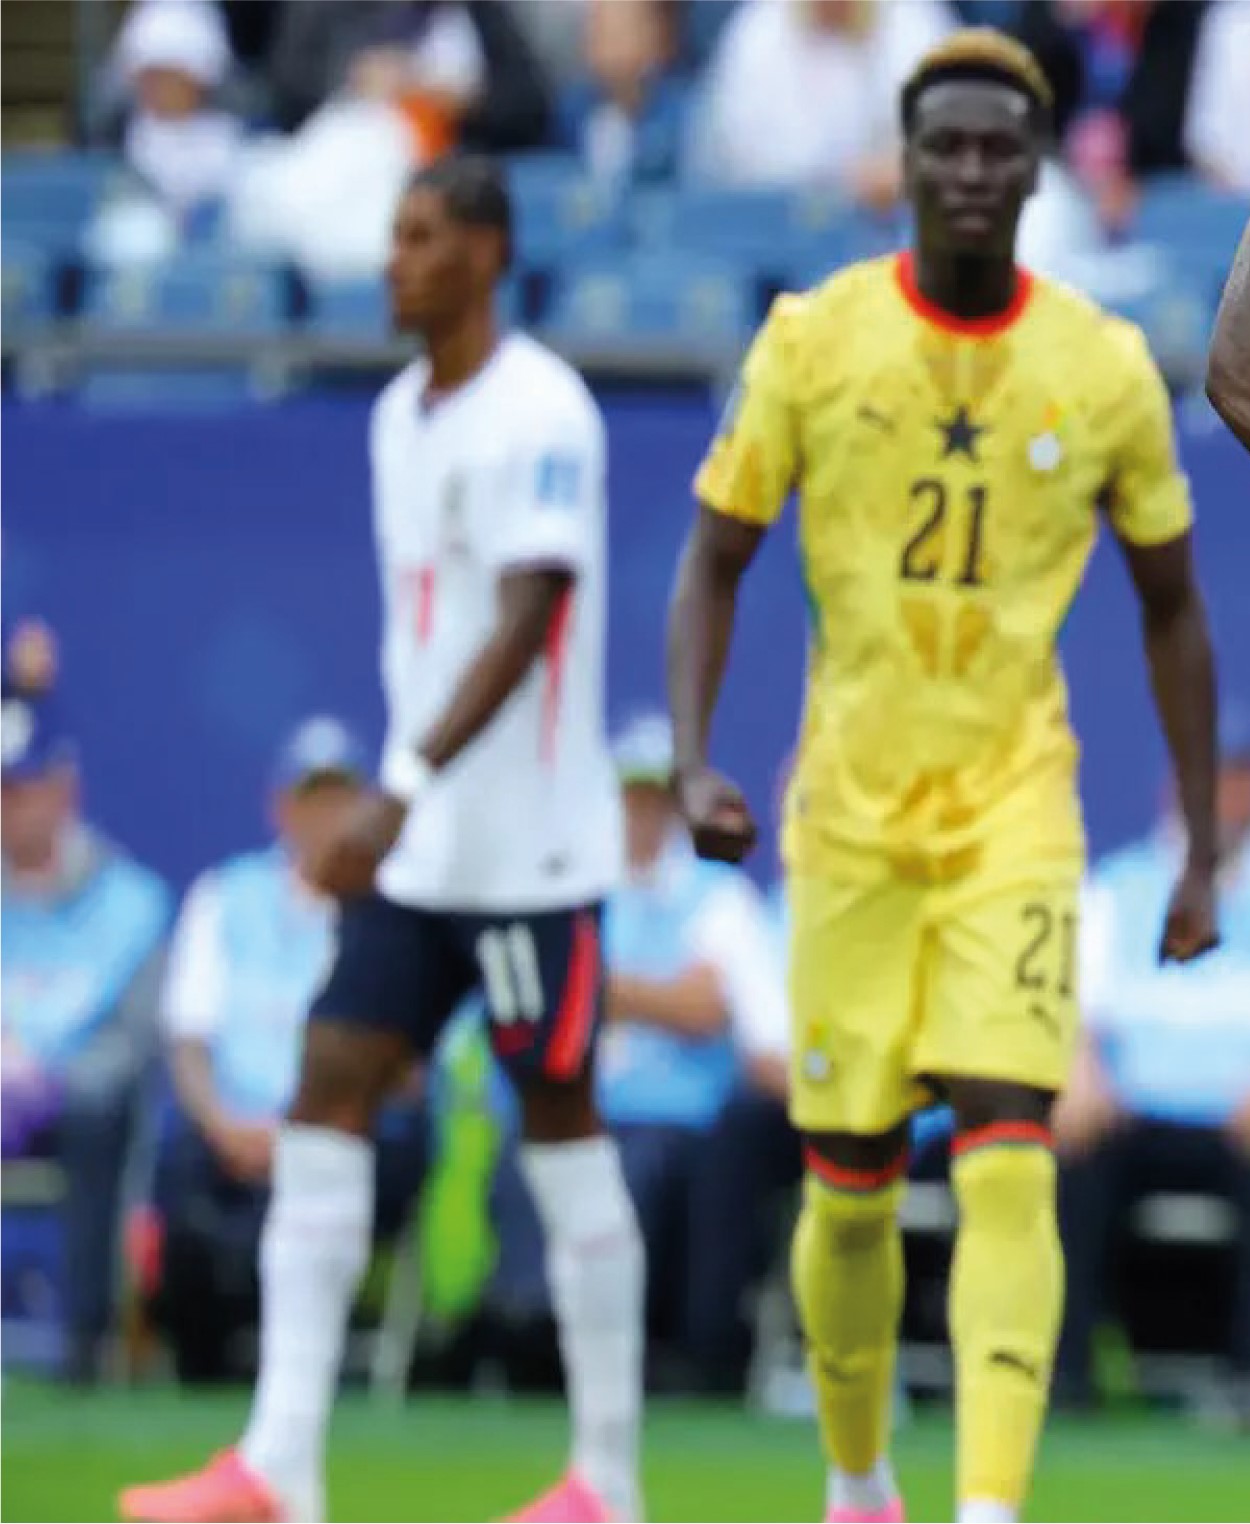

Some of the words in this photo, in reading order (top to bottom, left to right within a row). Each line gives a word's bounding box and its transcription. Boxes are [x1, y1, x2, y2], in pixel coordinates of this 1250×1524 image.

[899, 477, 988, 588] 21
[475, 924, 544, 1024] 11
[1014, 902, 1078, 998] 21
